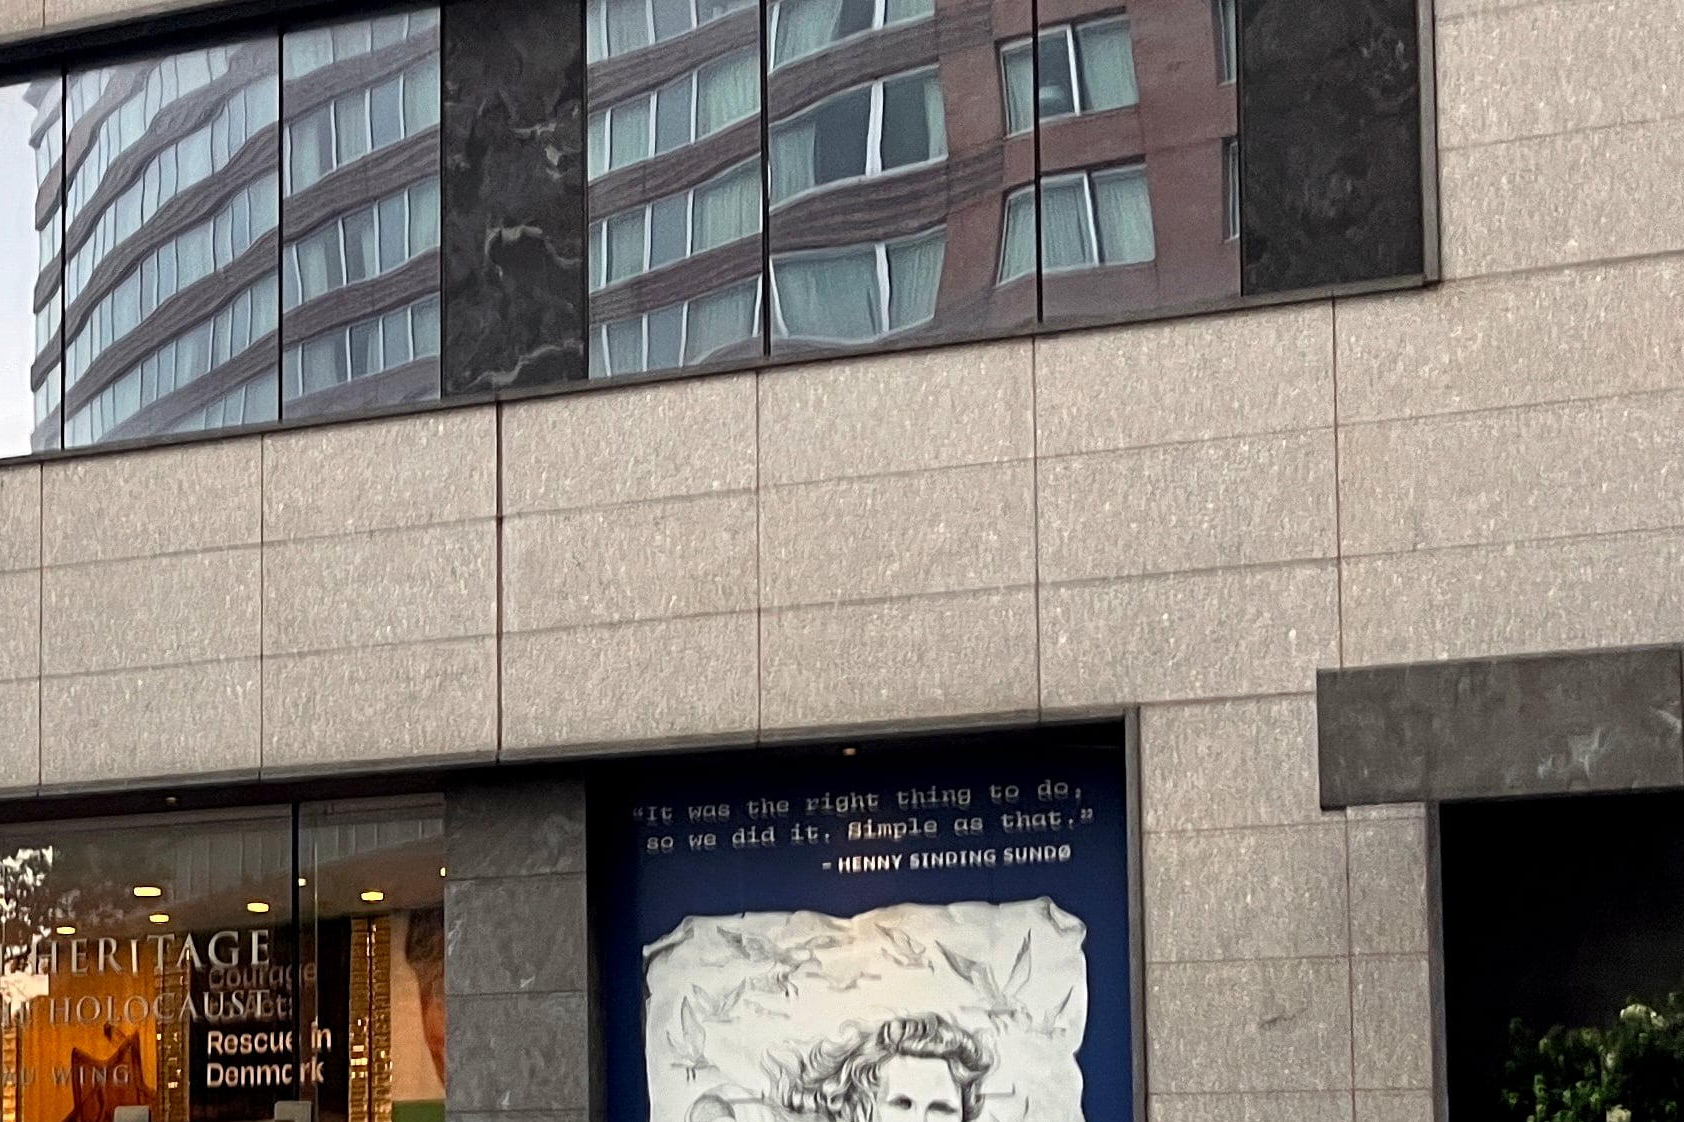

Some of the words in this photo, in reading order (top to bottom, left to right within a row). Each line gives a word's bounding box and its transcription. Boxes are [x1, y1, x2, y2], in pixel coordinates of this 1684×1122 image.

[688, 804, 731, 822] was
[747, 798, 790, 816] the
[806, 792, 879, 813] right
[897, 786, 971, 806] thing
[989, 784, 1020, 800] to
[647, 836, 674, 852] so
[689, 833, 716, 849] we
[732, 827, 775, 847] did
[791, 823, 830, 843] it.
[848, 818, 938, 840] Simple
[954, 817, 983, 834] as
[838, 854, 902, 873] HENNY
[910, 849, 996, 869] SINDING
[1003, 844, 1071, 864] SUNDØ
[31, 929, 270, 977] HERITAGE
[48, 988, 270, 1026] HOLOCAUST
[311, 1016, 332, 1052] in
[51, 1064, 130, 1088] WING
[206, 1056, 325, 1088] Denmark
